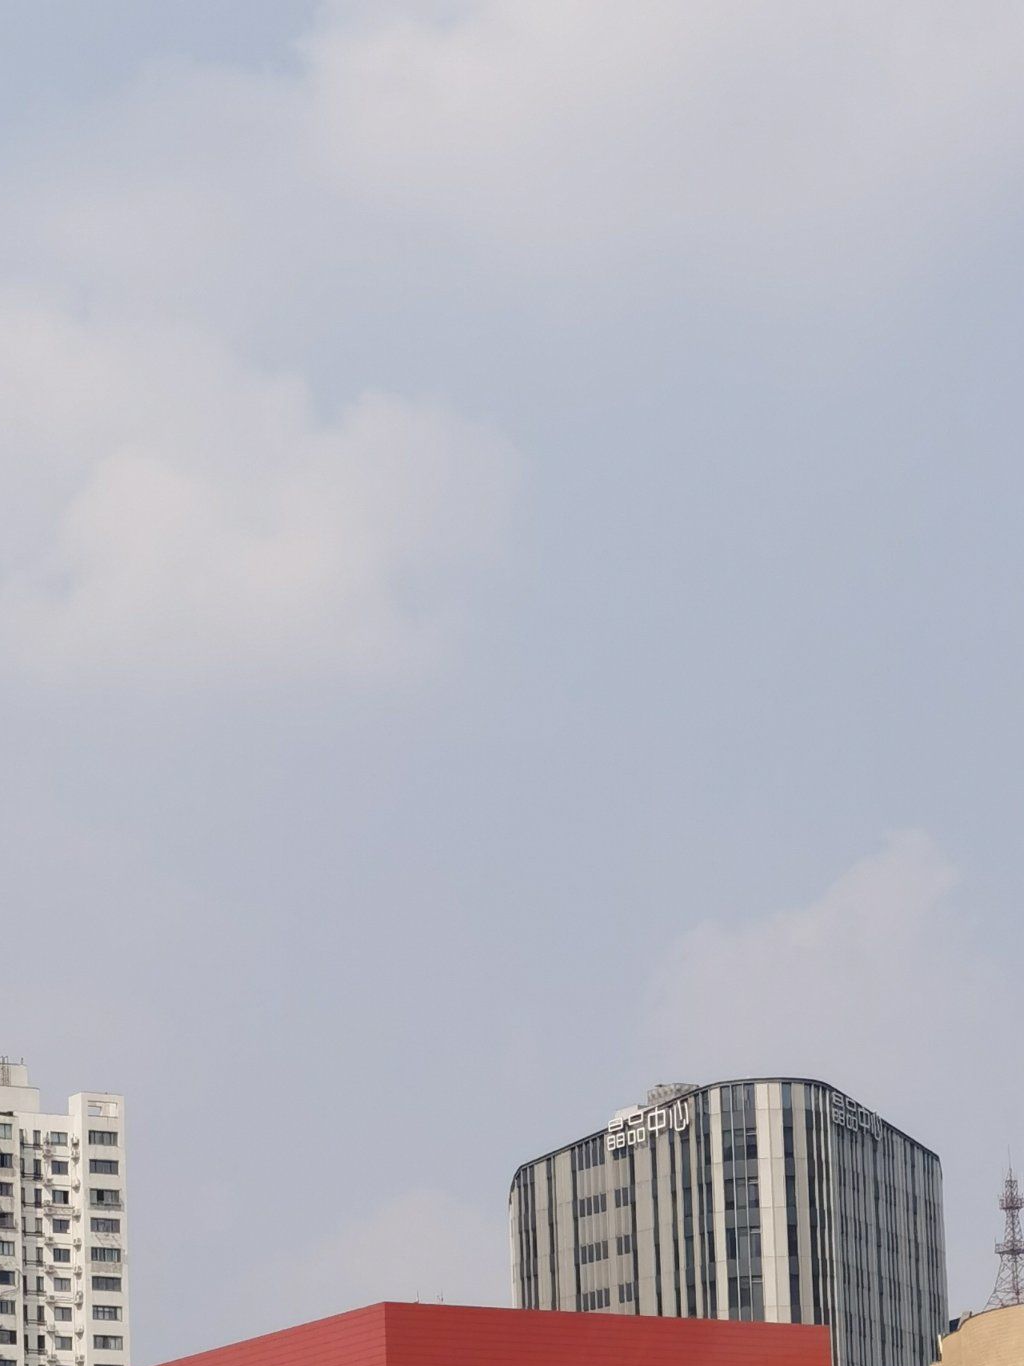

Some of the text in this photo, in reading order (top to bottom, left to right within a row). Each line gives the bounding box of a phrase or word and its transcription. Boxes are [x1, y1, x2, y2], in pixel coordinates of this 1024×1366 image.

[607, 1100, 689, 1151] 晶品中心
[833, 1091, 883, 1140] 晶品中心
